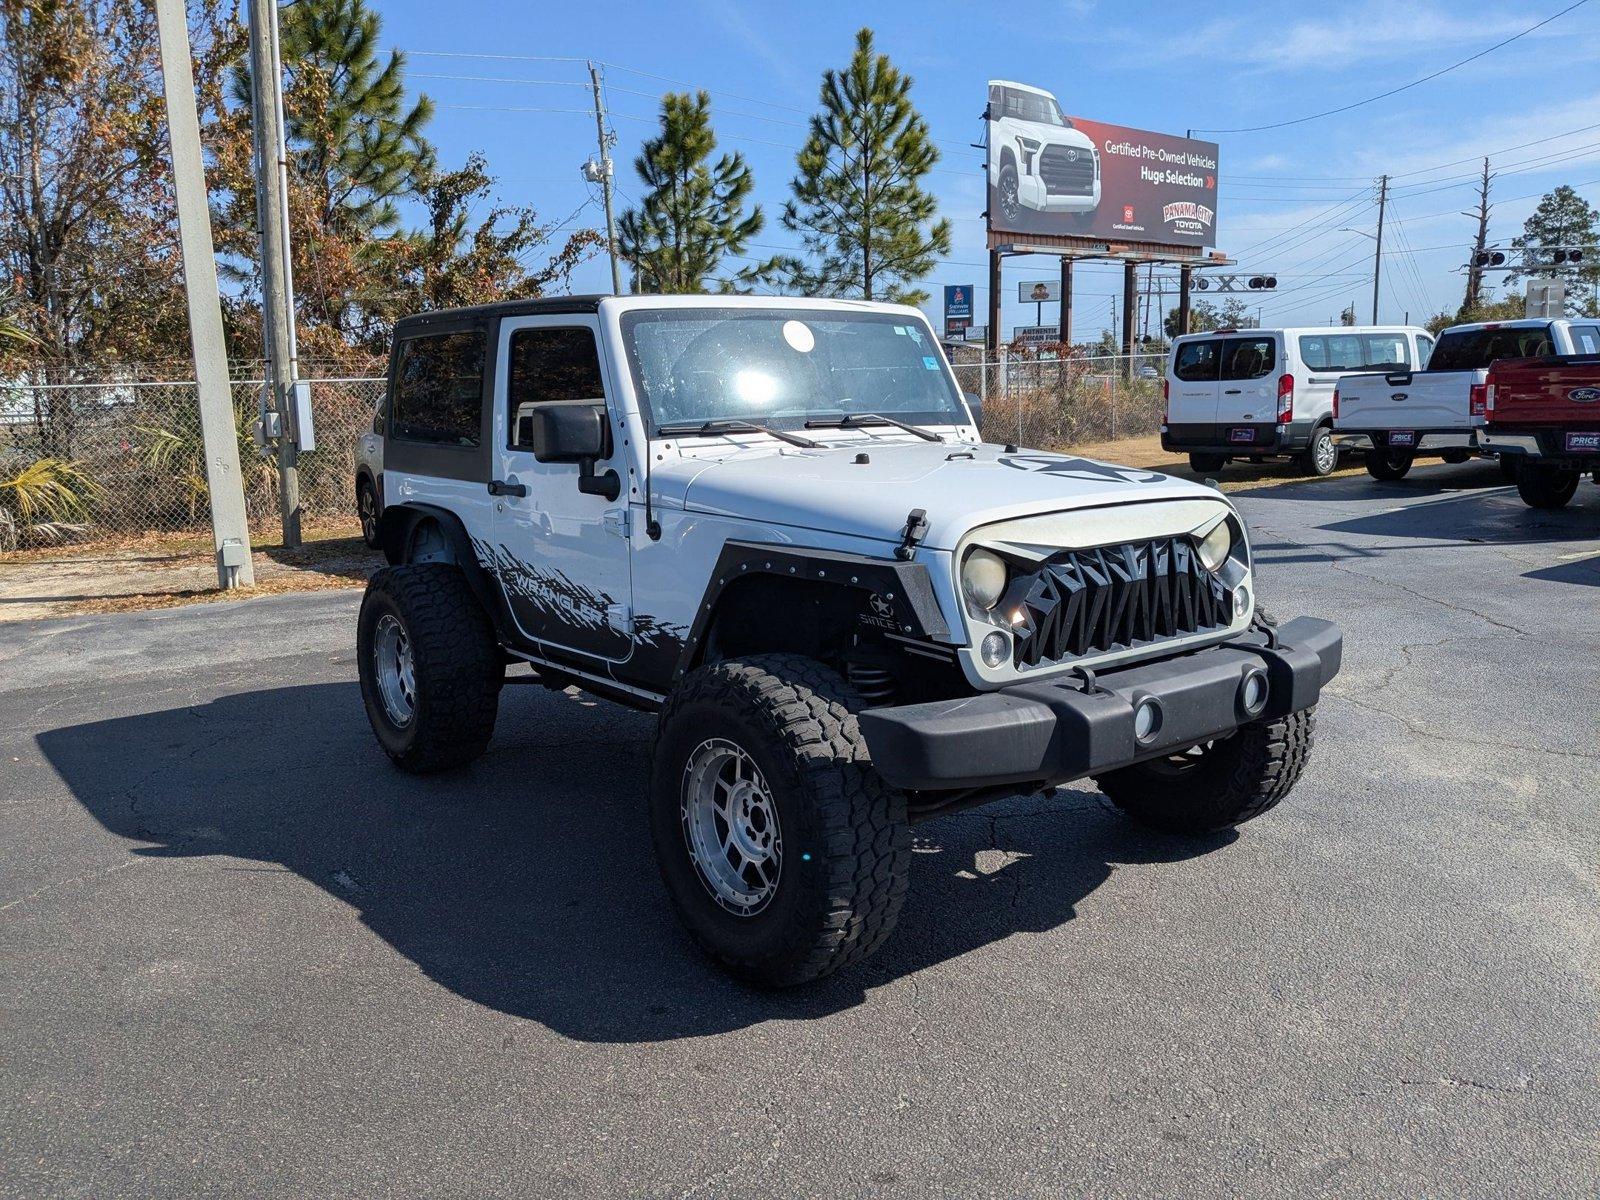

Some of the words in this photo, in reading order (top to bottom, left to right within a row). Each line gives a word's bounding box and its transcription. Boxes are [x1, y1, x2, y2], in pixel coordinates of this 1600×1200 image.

[1105, 140, 1141, 157] Certified
[1142, 146, 1186, 165] Pre-Owned
[1187, 153, 1216, 169] Vehicles
[1141, 165, 1165, 185] Huge
[1165, 170, 1204, 187] Selection
[1163, 202, 1197, 222] PANAMA
[1197, 204, 1214, 226] CITY
[1174, 220, 1203, 230] TOYOTA
[1022, 327, 1057, 335] AUTHENTIC
[1575, 390, 1596, 400] Ford
[515, 573, 603, 624] WRANGLER
[859, 613, 896, 630] SINCE
